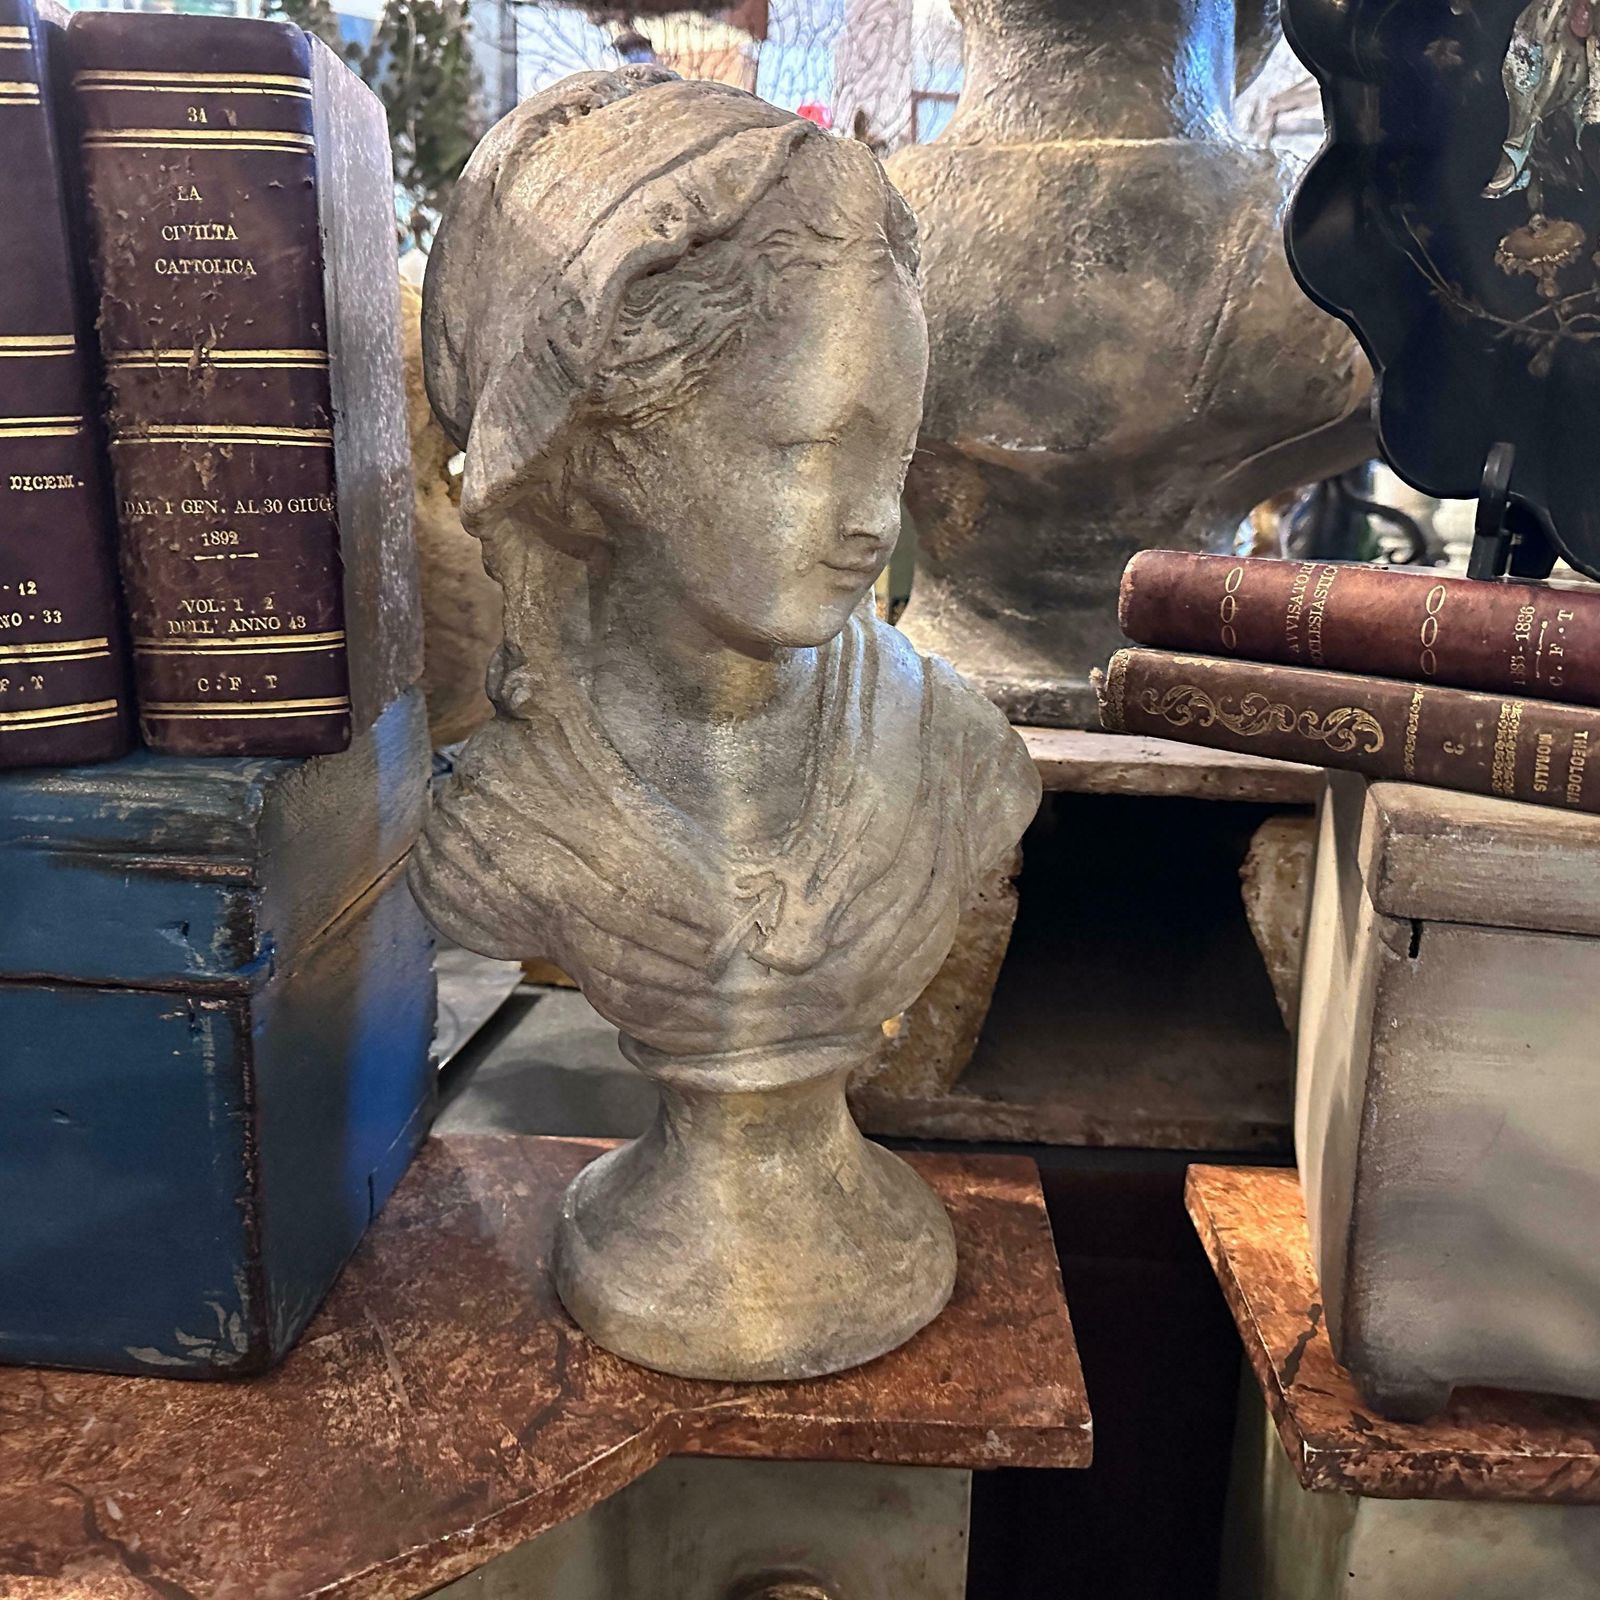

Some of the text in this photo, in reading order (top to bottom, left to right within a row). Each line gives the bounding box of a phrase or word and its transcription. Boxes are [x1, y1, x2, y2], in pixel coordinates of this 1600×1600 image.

[177, 185, 203, 201] LA
[161, 224, 239, 241] CIVILTA
[155, 258, 257, 276] CATTOLICA
[181, 499, 226, 514] GEN.
[234, 500, 260, 514] AL
[264, 499, 283, 513] 30
[201, 530, 239, 546] 1892
[19, 580, 37, 596] 12
[42, 609, 62, 624] 33
[228, 616, 281, 632] ANNO
[1442, 740, 1466, 757] 3
[1533, 733, 1553, 793] MORALIS
[1566, 730, 1589, 804] THEOLOGIA
